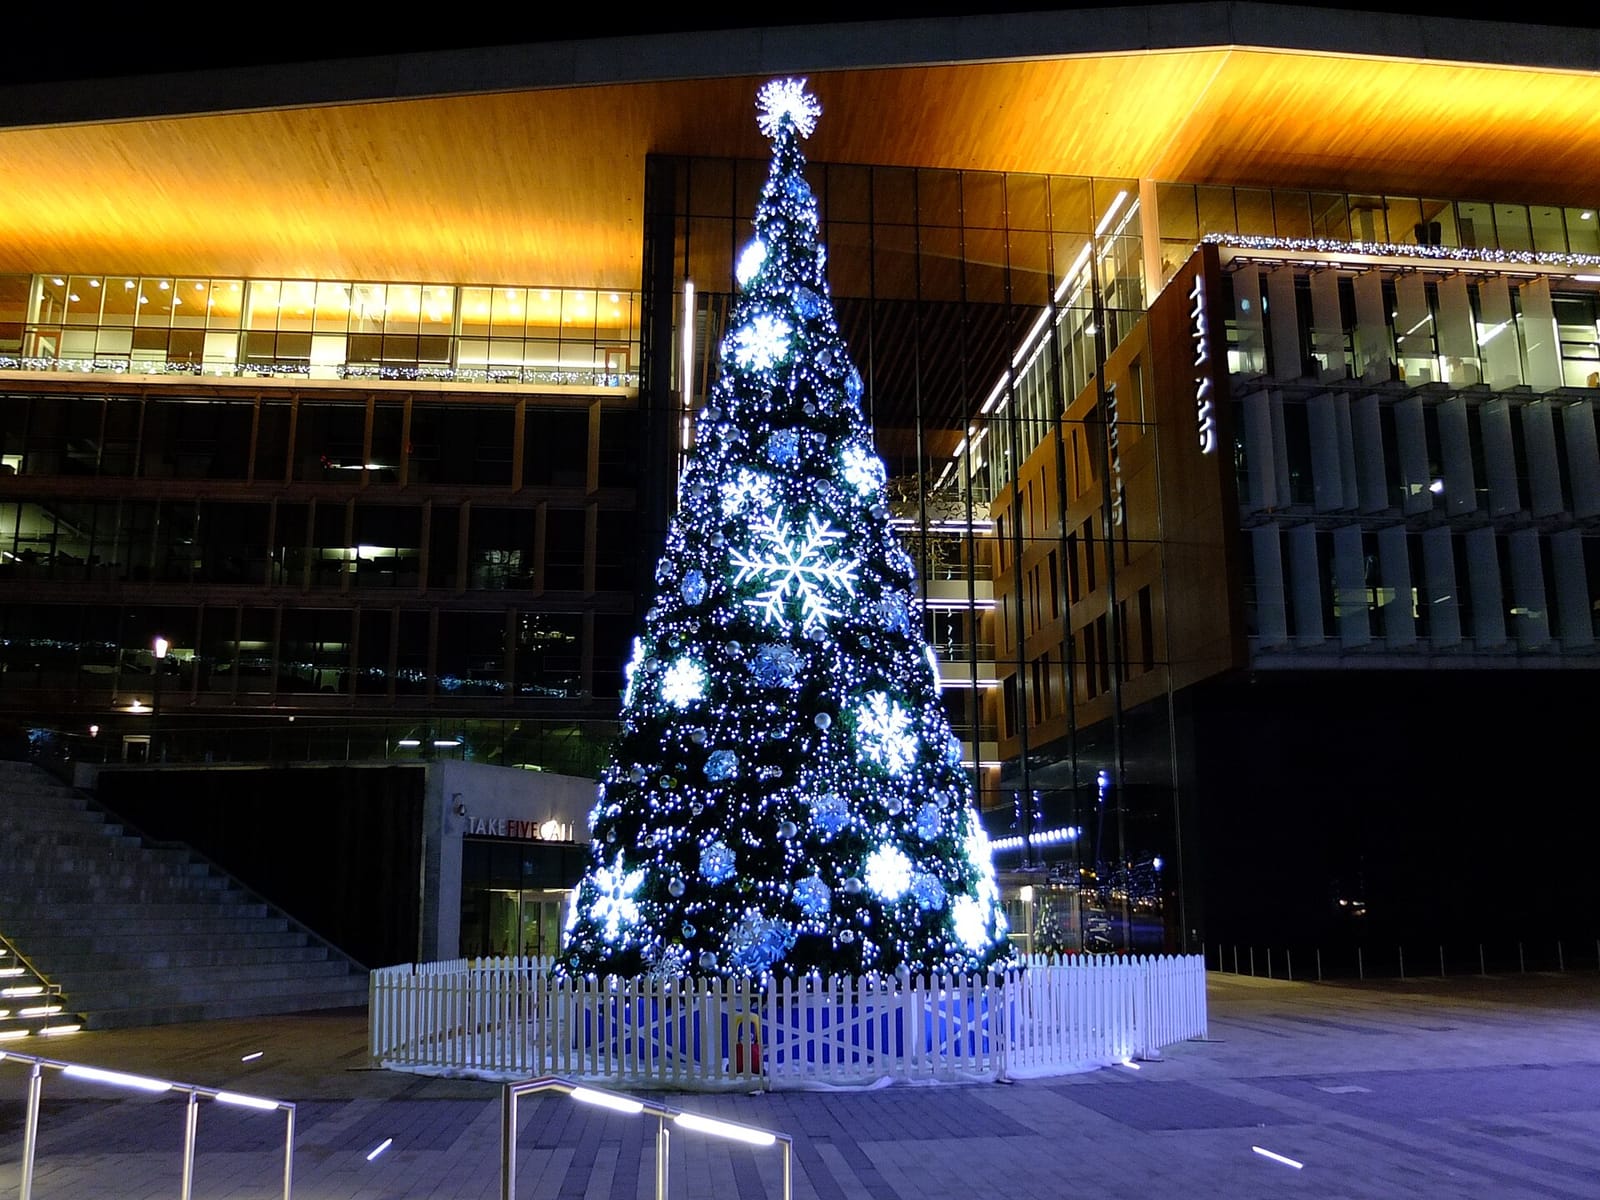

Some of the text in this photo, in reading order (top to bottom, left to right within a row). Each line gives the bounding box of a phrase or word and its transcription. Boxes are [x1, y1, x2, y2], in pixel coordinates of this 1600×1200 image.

[1188, 273, 1214, 454] CITY HALL
[468, 816, 505, 836] TAKE
[507, 819, 538, 840] FIVE
